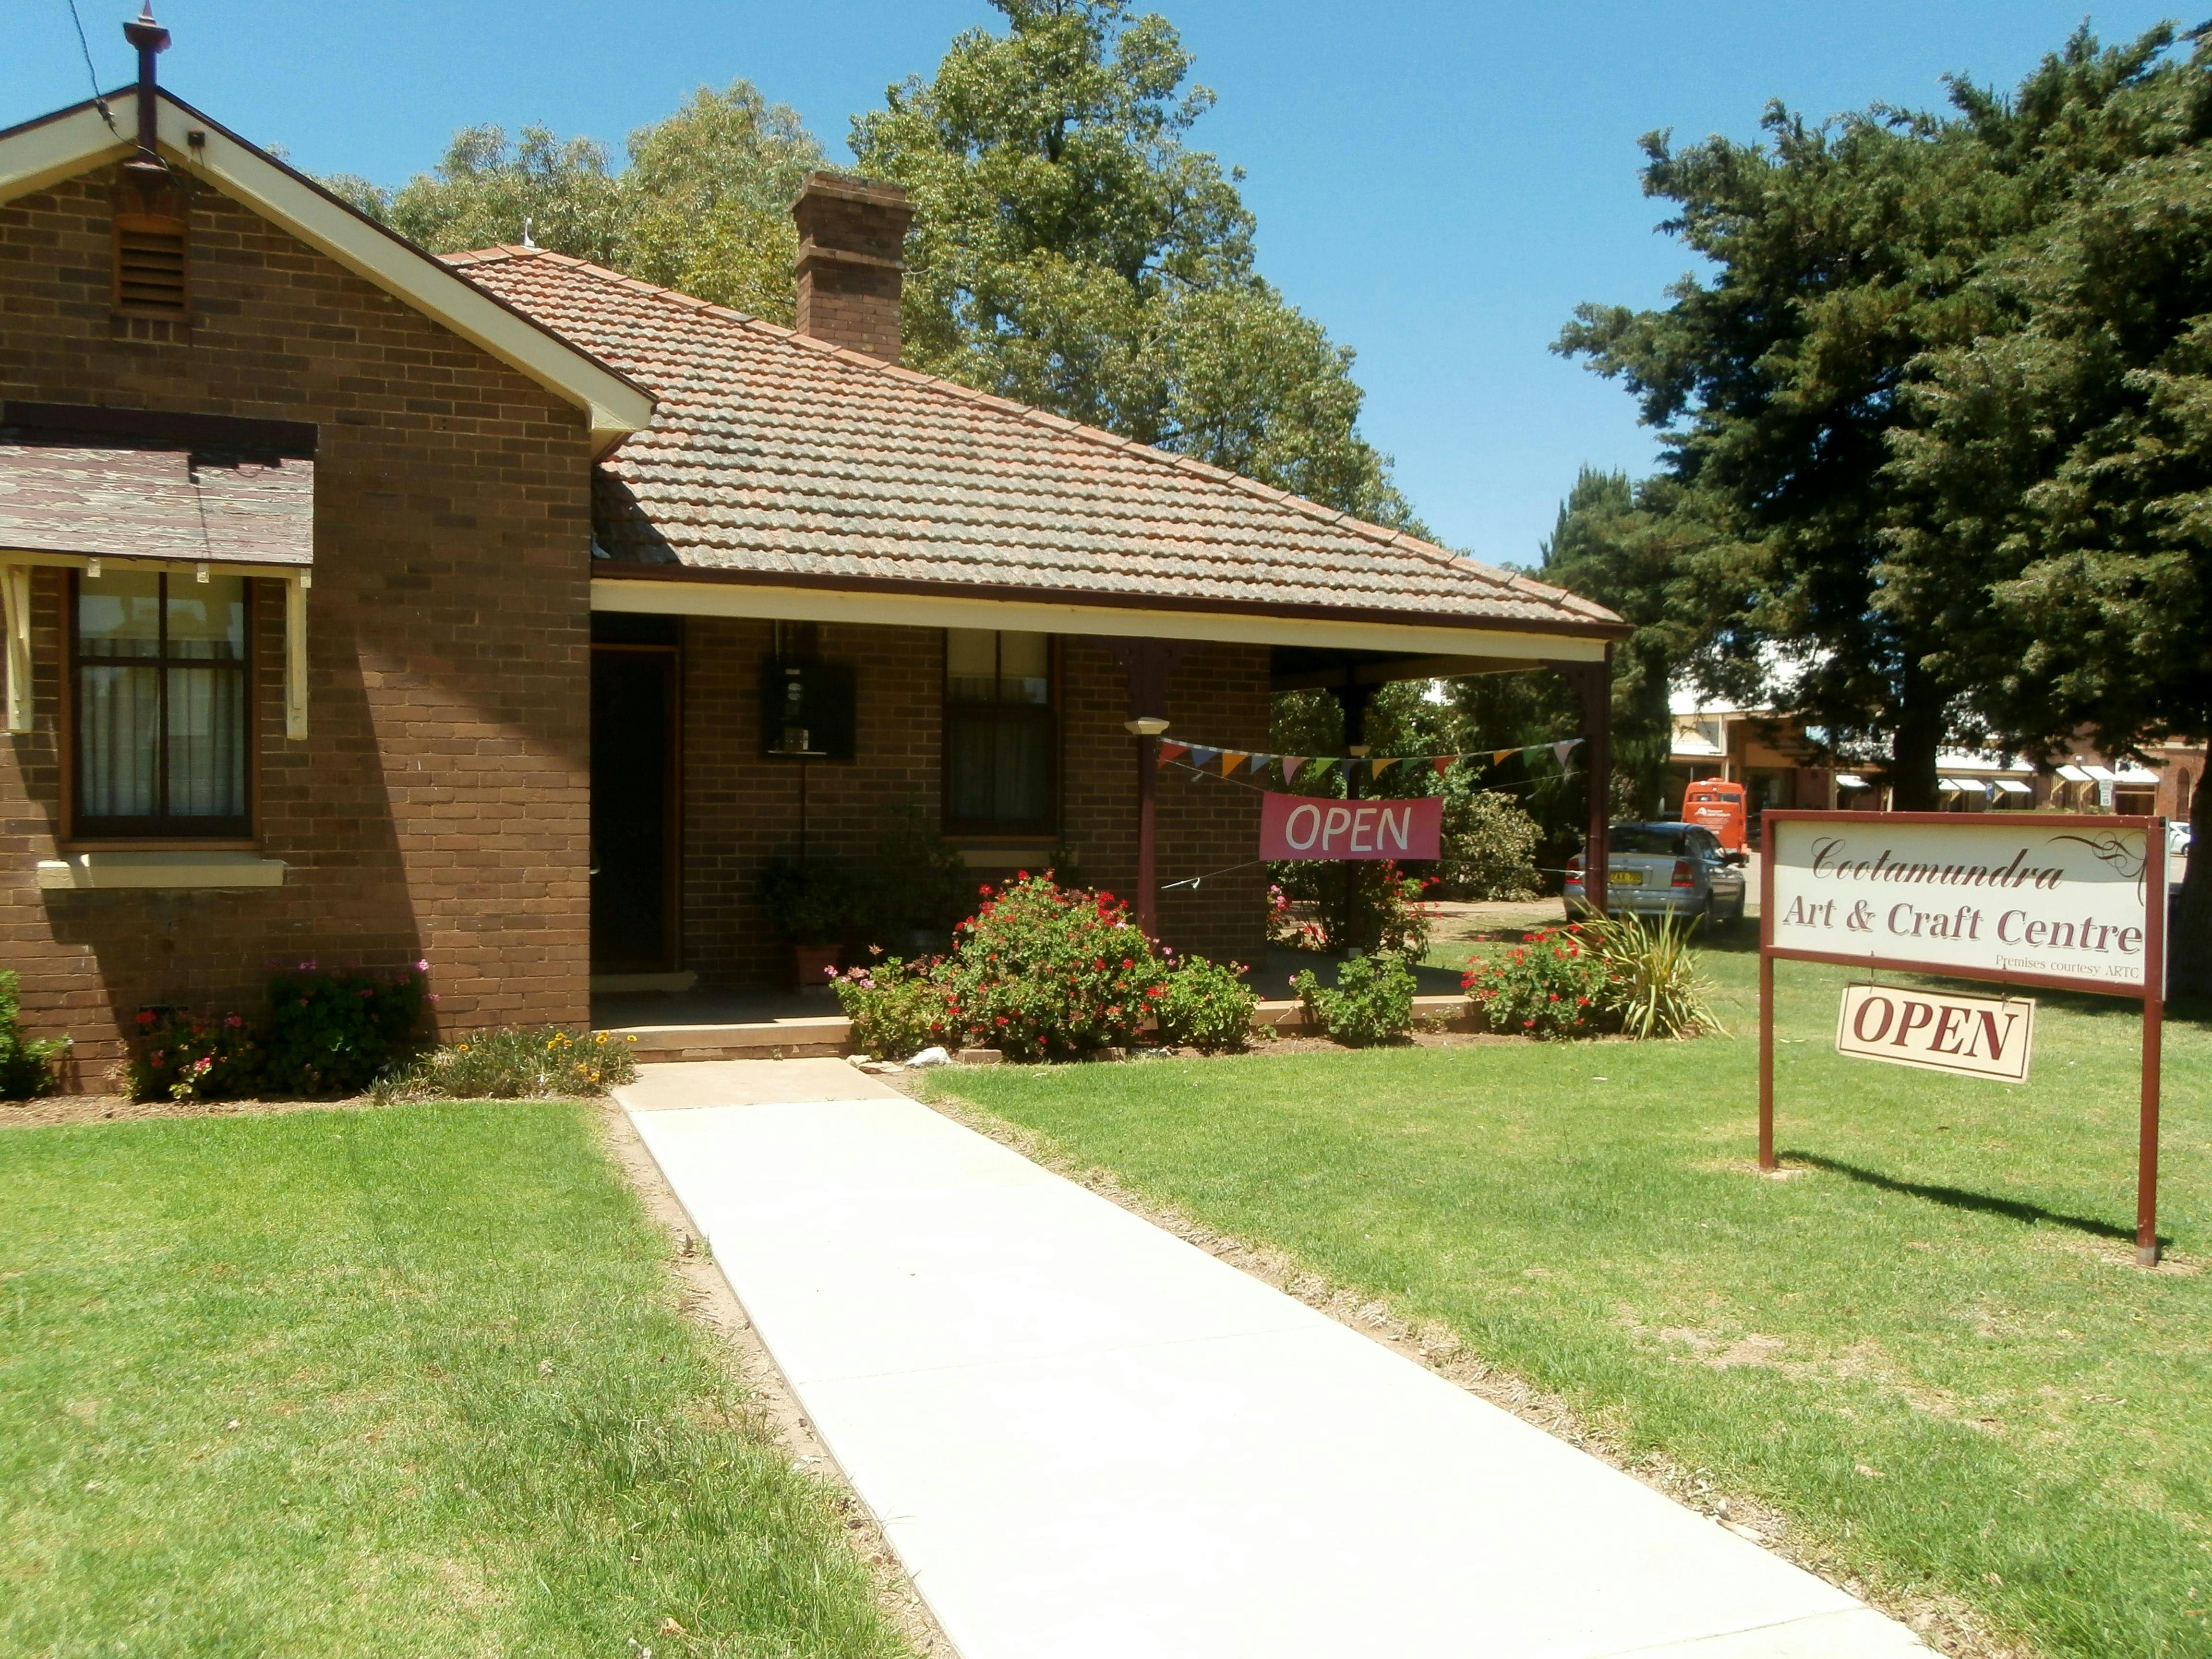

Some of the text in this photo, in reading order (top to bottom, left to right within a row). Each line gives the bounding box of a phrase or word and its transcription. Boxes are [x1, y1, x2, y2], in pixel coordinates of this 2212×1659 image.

[1286, 804, 1411, 852] OPEN
[1811, 837, 2064, 890] Cootamundra
[1782, 895, 2143, 955] Art & Craft Centre
[1996, 954, 2139, 978] Premises courtesy ARTC
[1853, 997, 2019, 1060] OPEN
